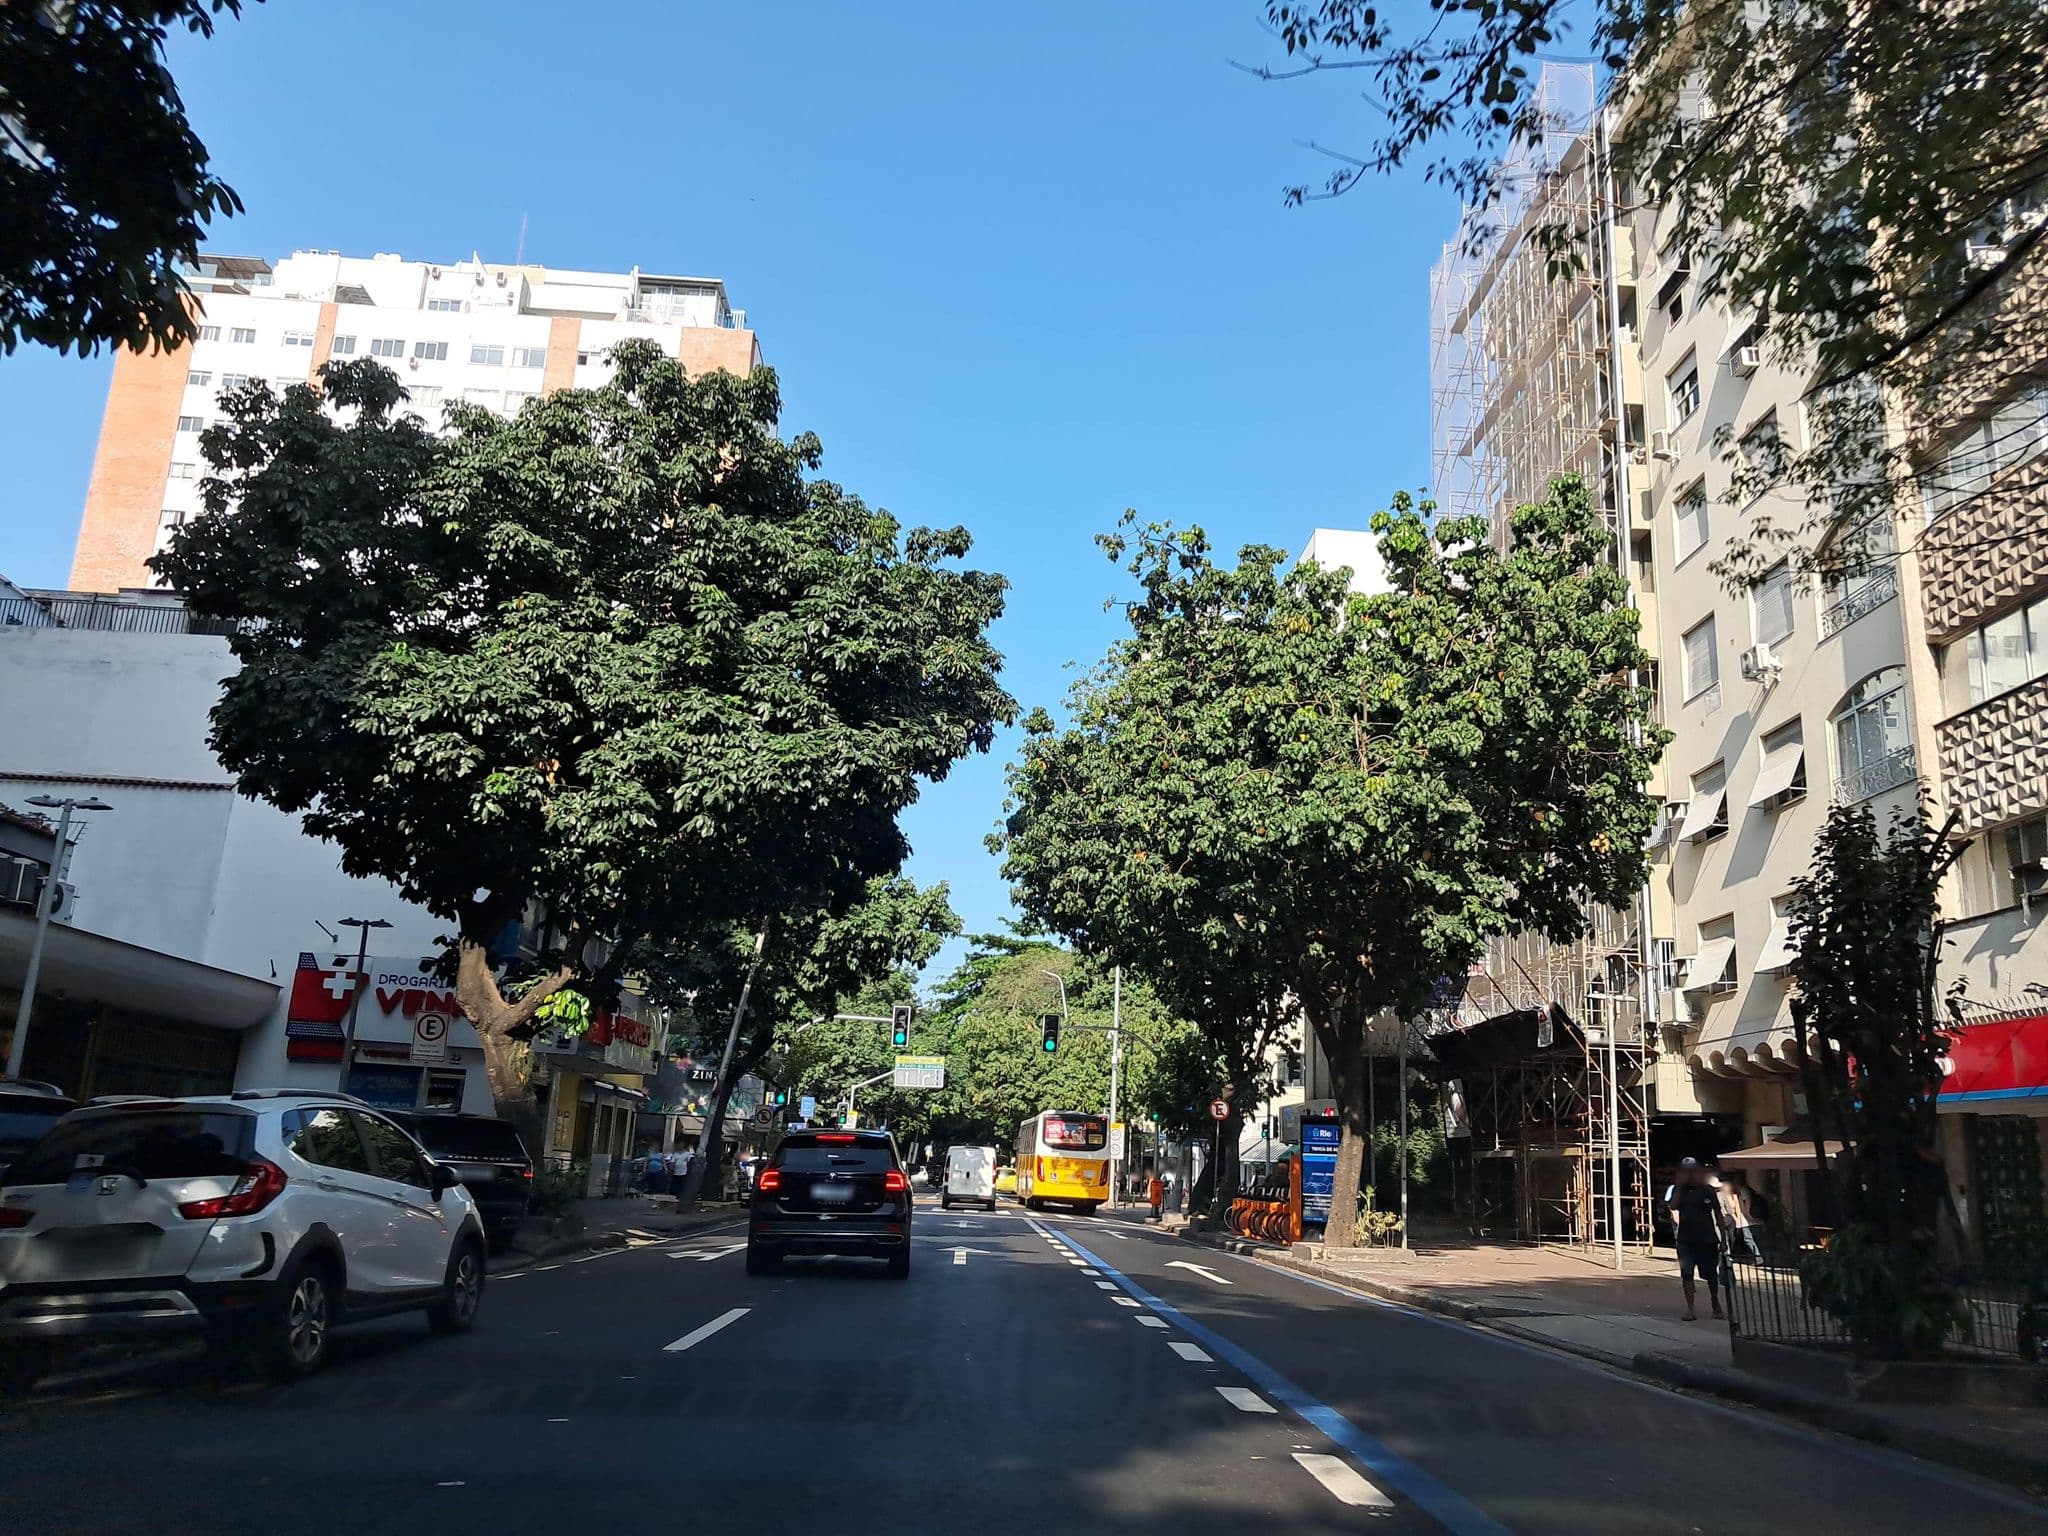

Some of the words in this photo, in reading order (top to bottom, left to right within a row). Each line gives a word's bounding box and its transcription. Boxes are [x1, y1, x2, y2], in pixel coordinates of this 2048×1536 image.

[378, 974, 451, 989] DROGARI
[425, 1020, 436, 1035] E
[692, 1070, 718, 1080] ZIN
[1215, 1103, 1224, 1116] E
